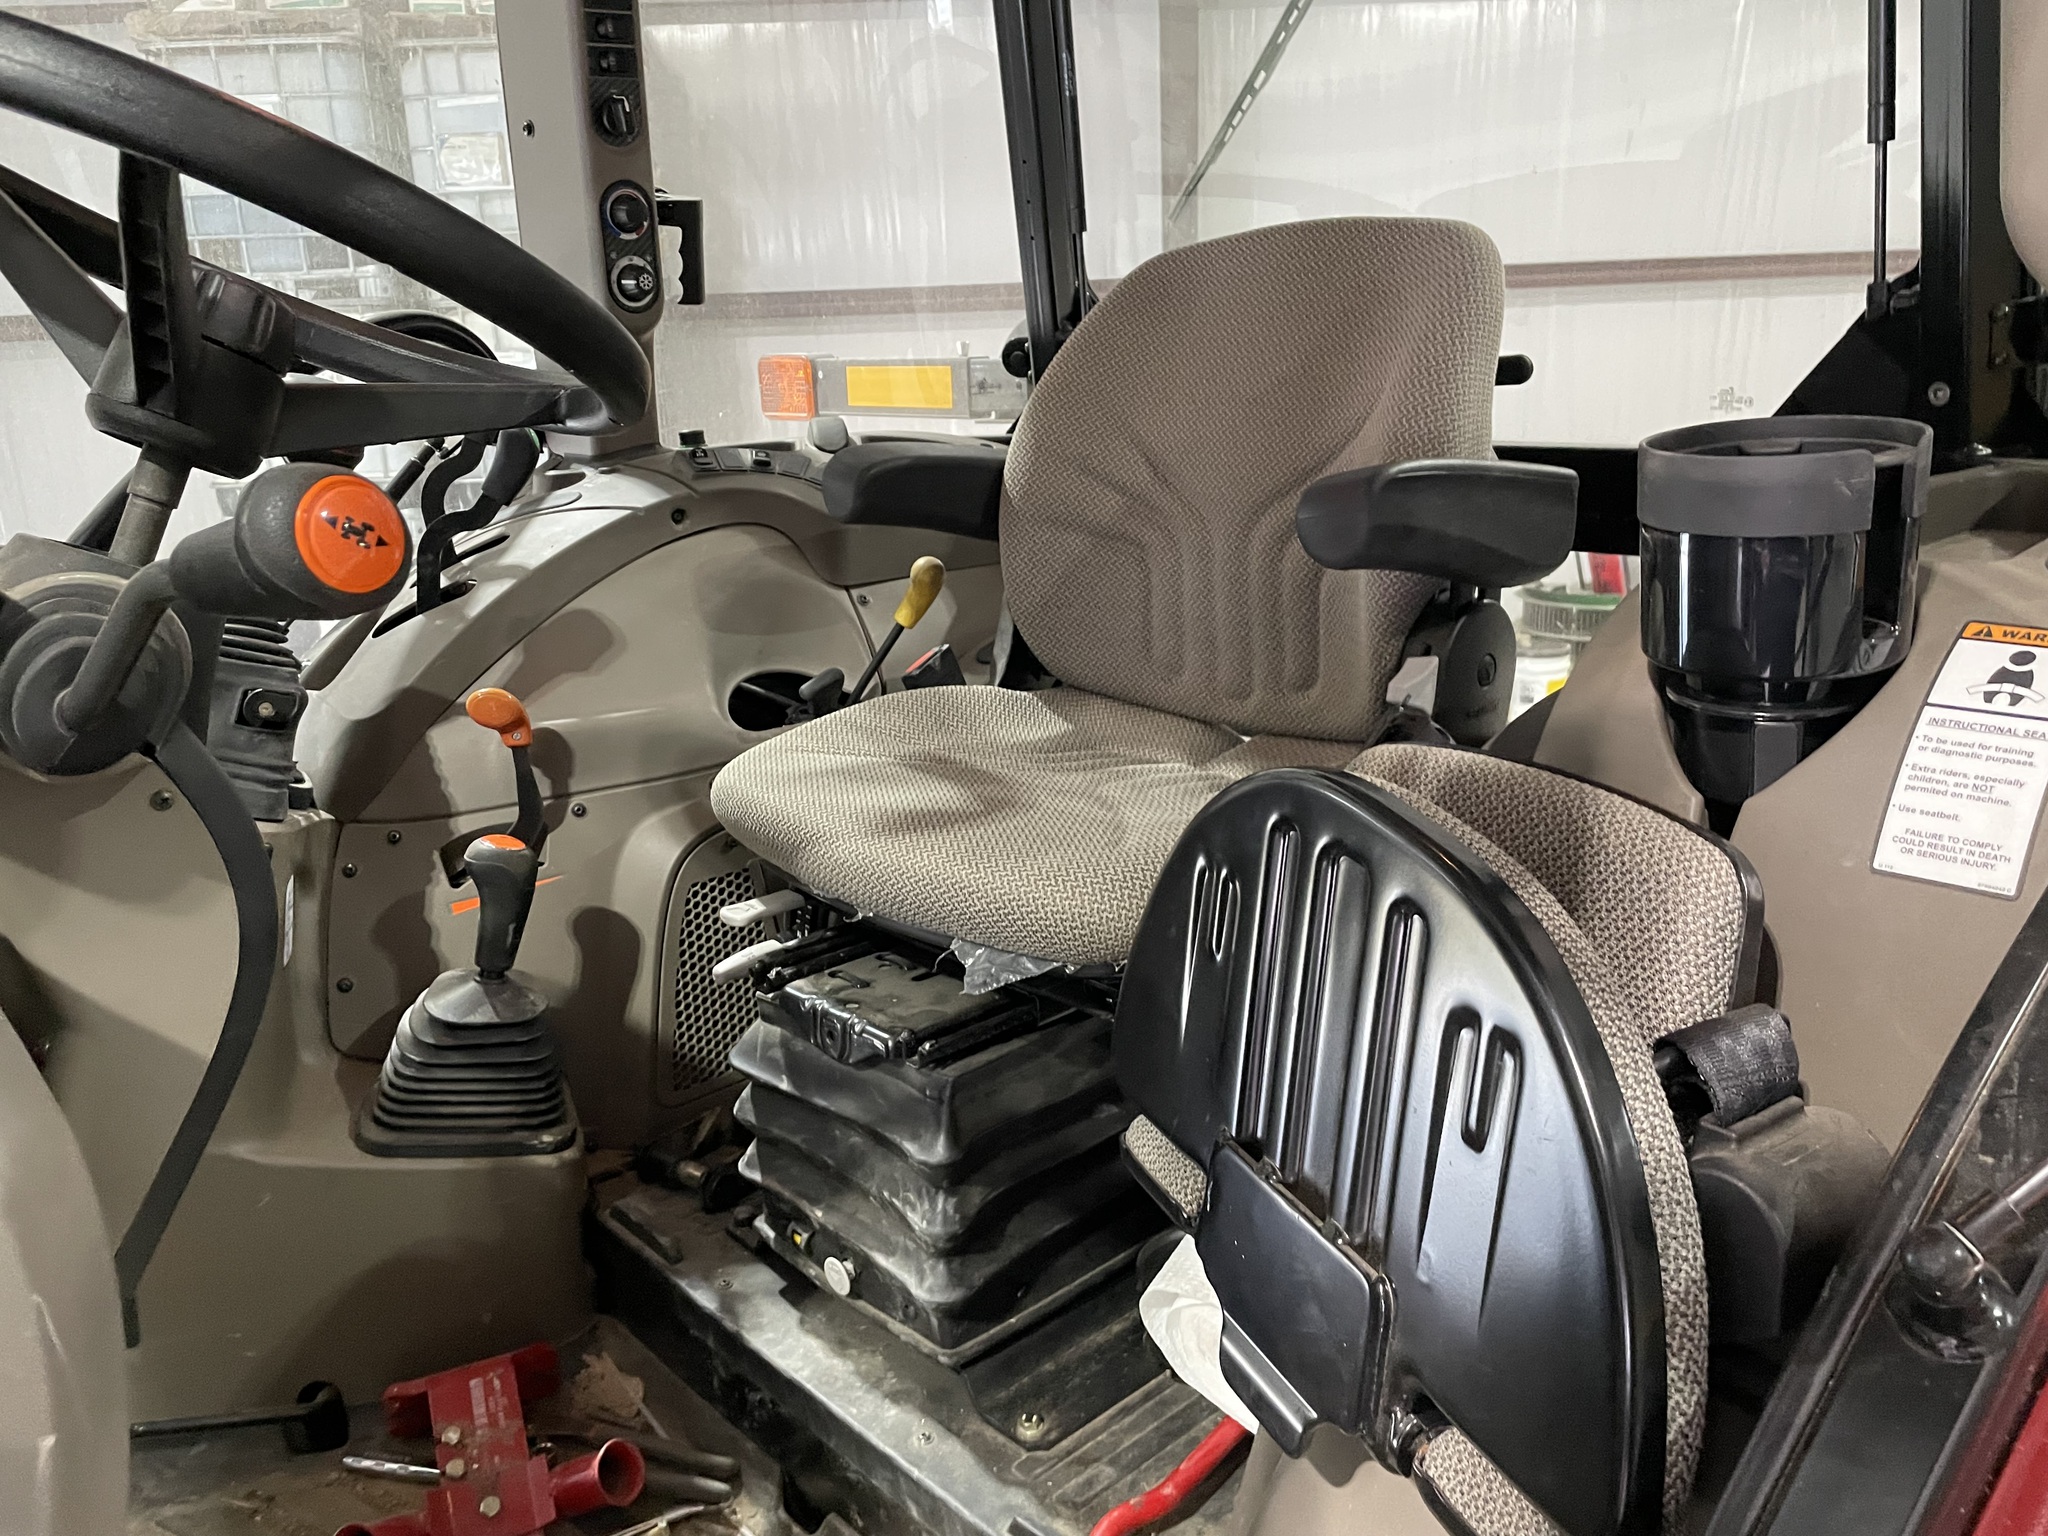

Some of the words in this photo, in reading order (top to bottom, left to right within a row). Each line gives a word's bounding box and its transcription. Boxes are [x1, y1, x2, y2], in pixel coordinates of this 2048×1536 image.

[2002, 629, 2047, 642] WAR
[1926, 717, 2019, 736] INSTRUCTIONAL
[1922, 735, 1934, 743] To
[1936, 737, 1948, 745] be
[1950, 739, 1976, 749] used
[1978, 743, 1992, 751] for
[1994, 746, 2035, 758] training
[1931, 745, 1983, 760] diagnostic
[1985, 754, 2037, 768] purposes.
[1907, 773, 1950, 787] children,
[1953, 781, 1969, 789] are
[1971, 783, 1996, 795] NOT
[1910, 763, 1937, 775] Extra
[1939, 768, 1970, 780] riders,
[1973, 775, 2026, 789] especially
[1950, 791, 1963, 799] on
[1966, 793, 2012, 807] machine.
[1898, 803, 1916, 814] Use
[1919, 808, 1961, 822] seatbelt.
[1892, 835, 1924, 847] COULD
[1927, 841, 1964, 855] RESULT
[1966, 848, 1976, 857] IN
[1978, 850, 2011, 864] DEATH
[1904, 828, 1944, 842] FAILURE
[1947, 835, 1960, 844] TO
[1962, 838, 2003, 852] COMPLY
[1900, 846, 1914, 855] OR
[1916, 849, 1959, 864] SERIOUS
[1960, 858, 1997, 872] INJURY.
